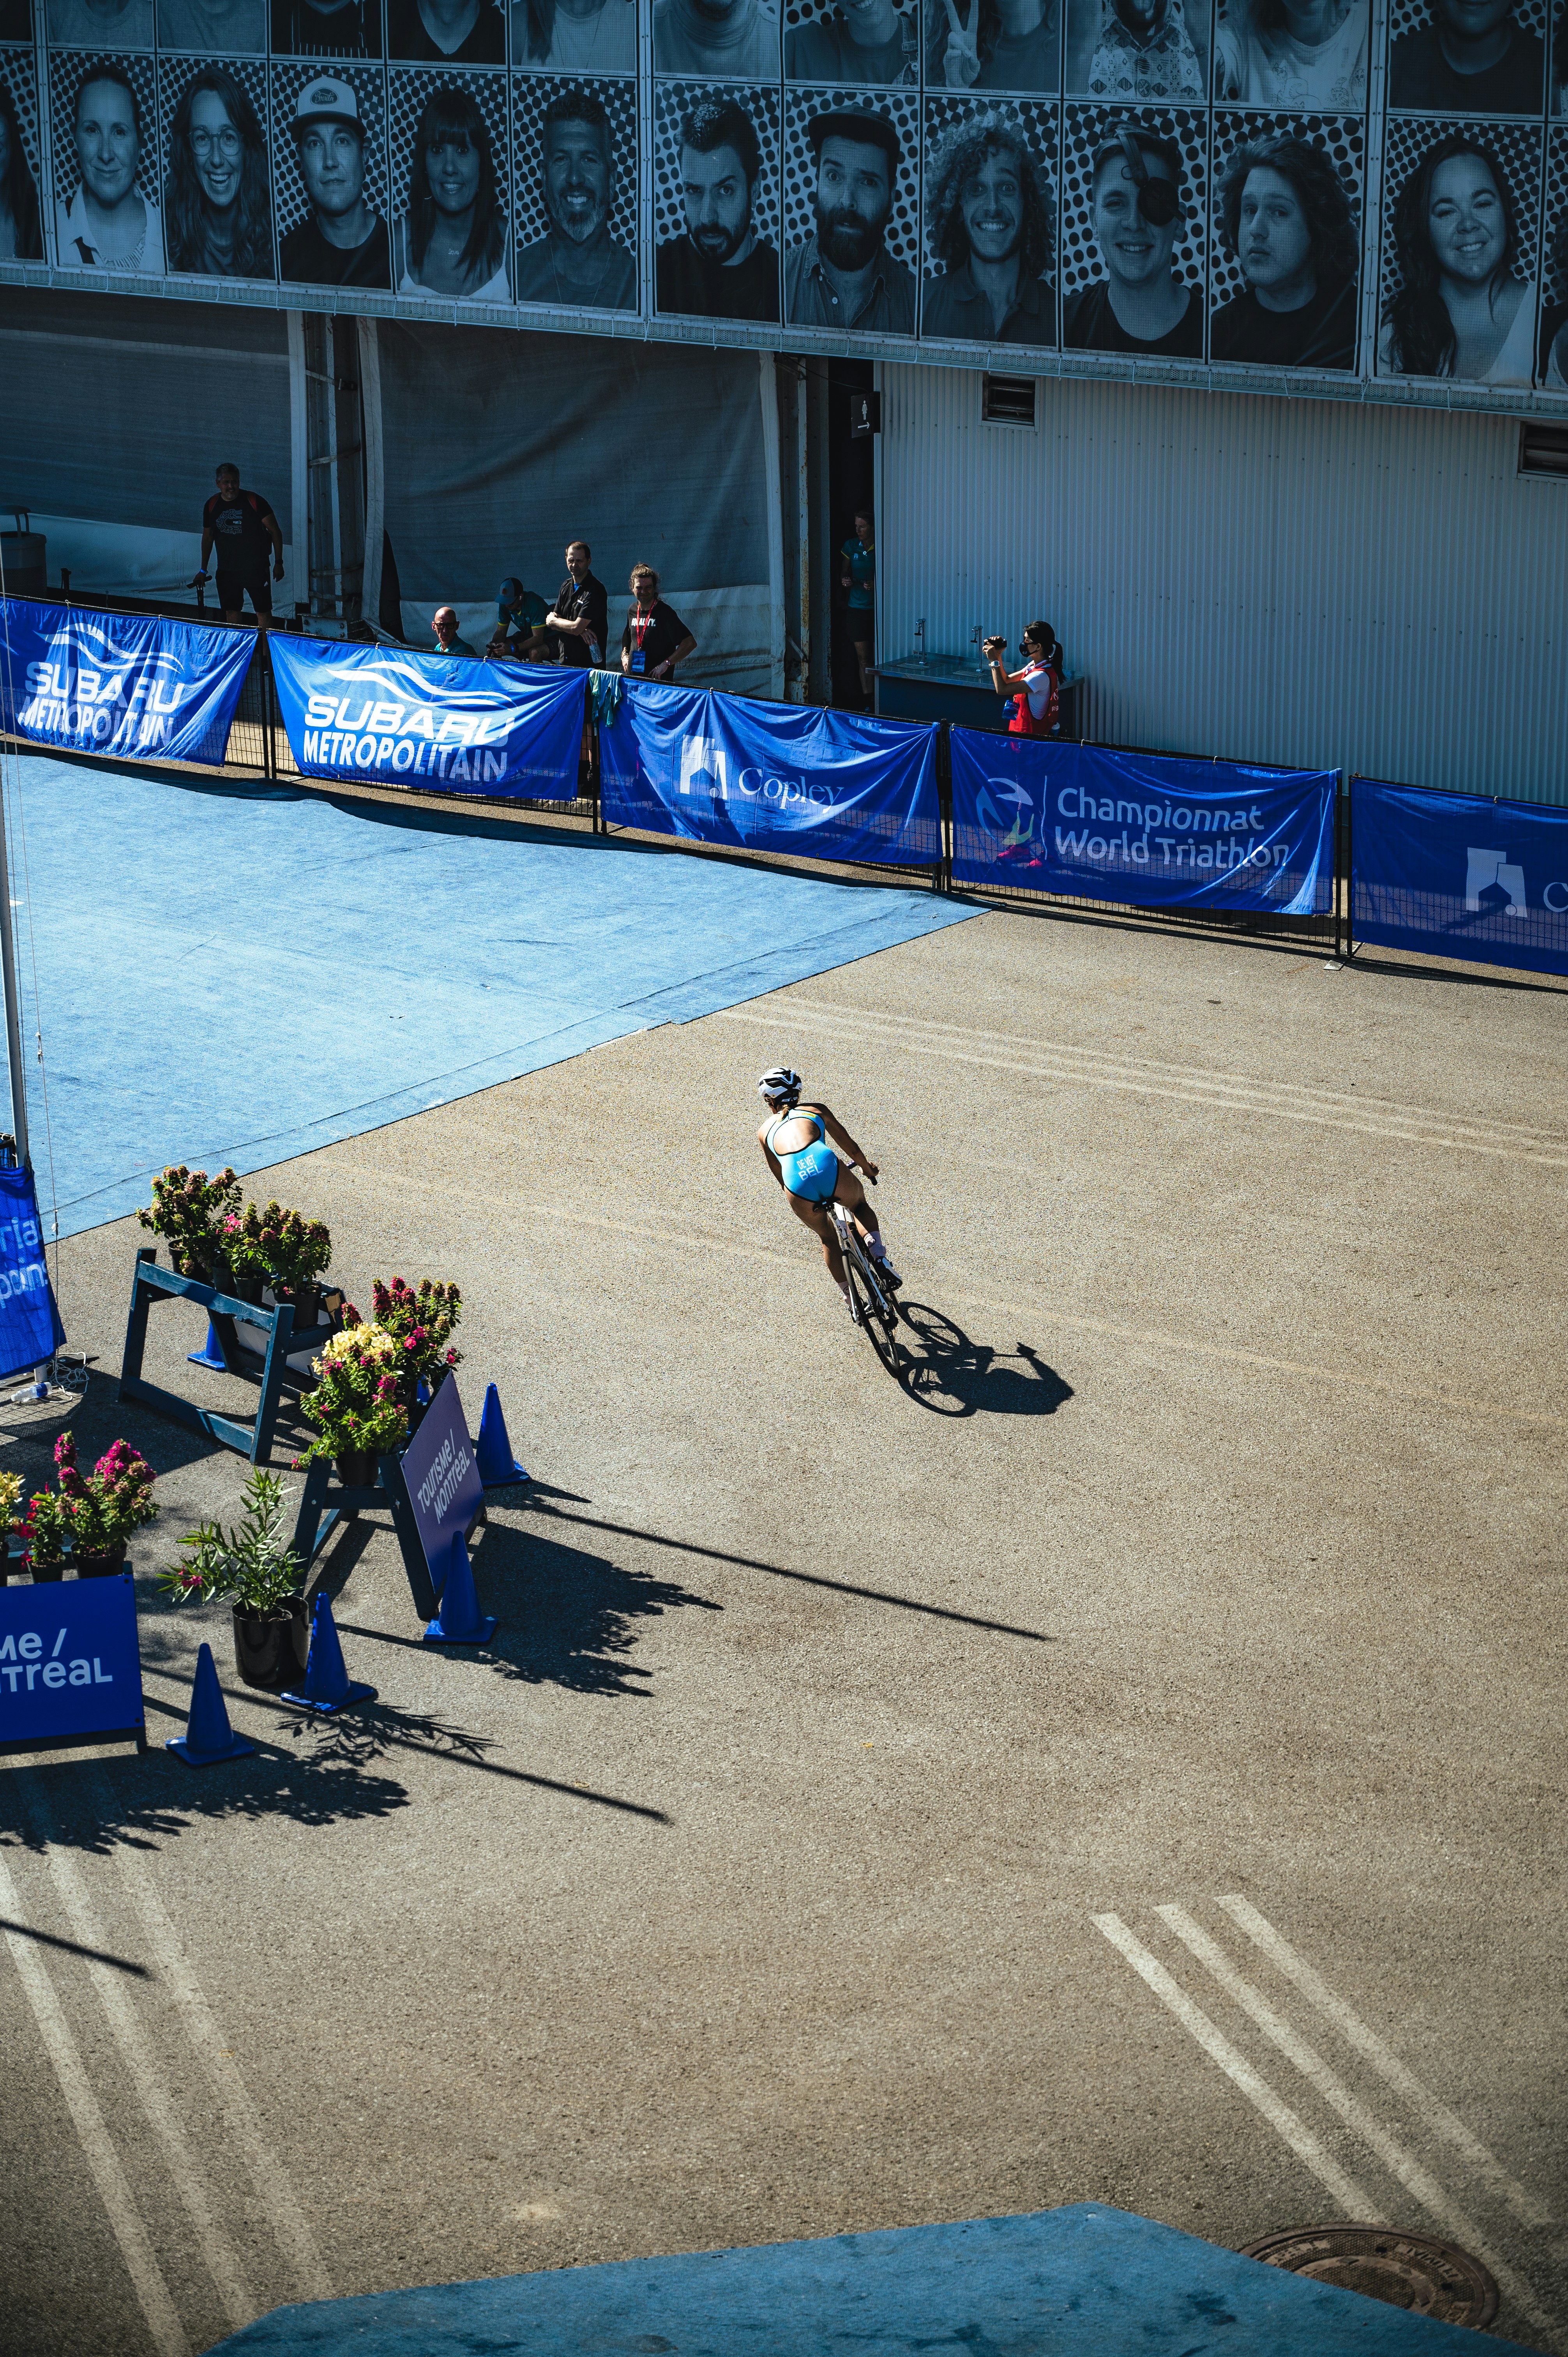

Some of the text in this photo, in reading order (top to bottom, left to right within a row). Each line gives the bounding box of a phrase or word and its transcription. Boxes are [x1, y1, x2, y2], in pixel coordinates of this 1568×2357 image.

[631, 618, 656, 626] EQALTY.
[25, 661, 185, 713] SUBARU
[18, 695, 174, 747] METROPOLITAIN
[304, 696, 515, 747] SUBARU
[304, 730, 508, 782] METROPOLITAIN
[738, 767, 844, 813] Copley
[1058, 787, 1264, 833] Championnat
[1055, 826, 1289, 869] World Triathlon
[796, 1154, 816, 1170] DE VET
[798, 1164, 823, 1181] BEL
